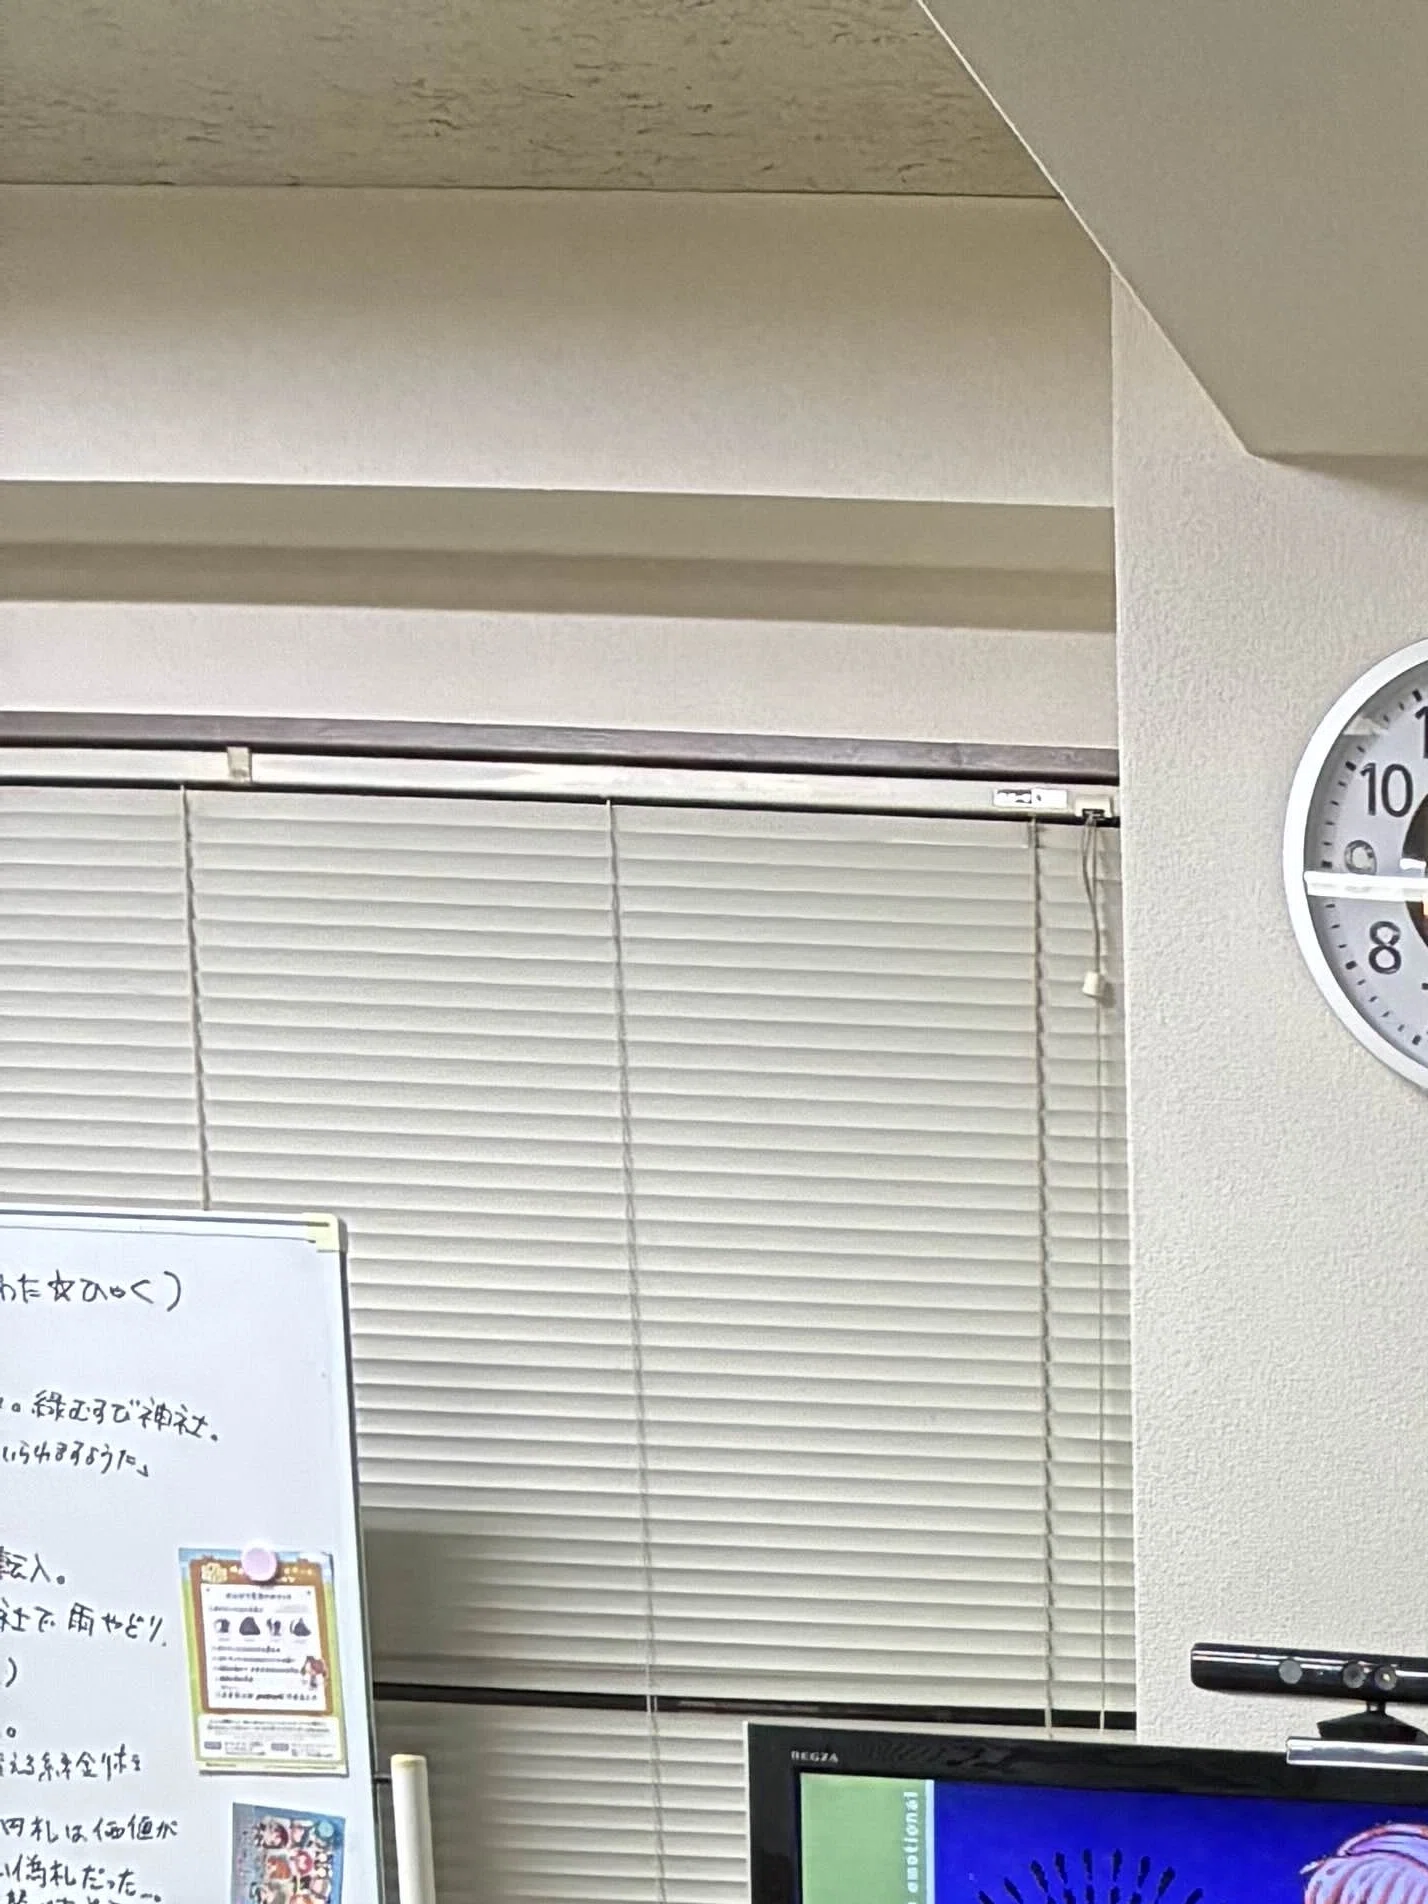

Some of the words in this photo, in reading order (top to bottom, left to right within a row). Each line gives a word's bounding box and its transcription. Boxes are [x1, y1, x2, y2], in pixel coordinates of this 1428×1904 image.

[1361, 763, 1414, 817] 10
[1368, 921, 1402, 974] 8
[791, 1750, 839, 1763] REGZA
[904, 1790, 920, 1893] emotional
